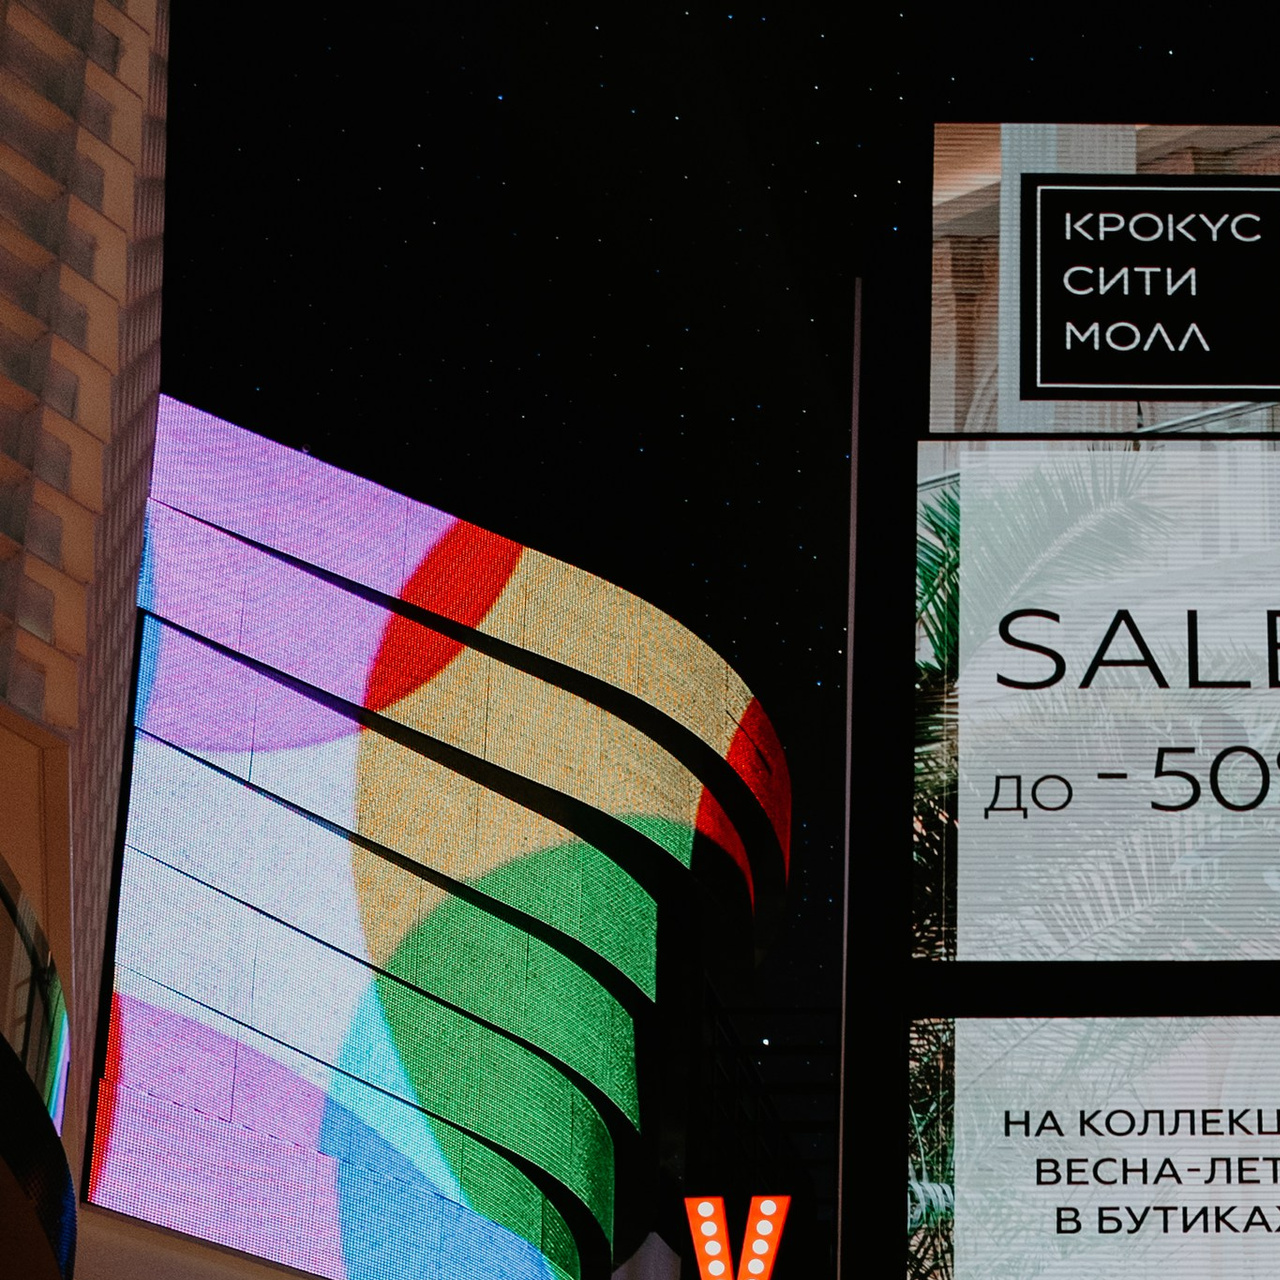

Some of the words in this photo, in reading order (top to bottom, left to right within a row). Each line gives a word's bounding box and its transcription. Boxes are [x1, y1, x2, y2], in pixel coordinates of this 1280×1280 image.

[1063, 212, 1263, 243] КРОКУС
[1062, 266, 1199, 297] СИТИ
[1064, 322, 1211, 352] МОЛЛ
[1002, 1109, 1064, 1138] НА
[1054, 1206, 1083, 1234] В
